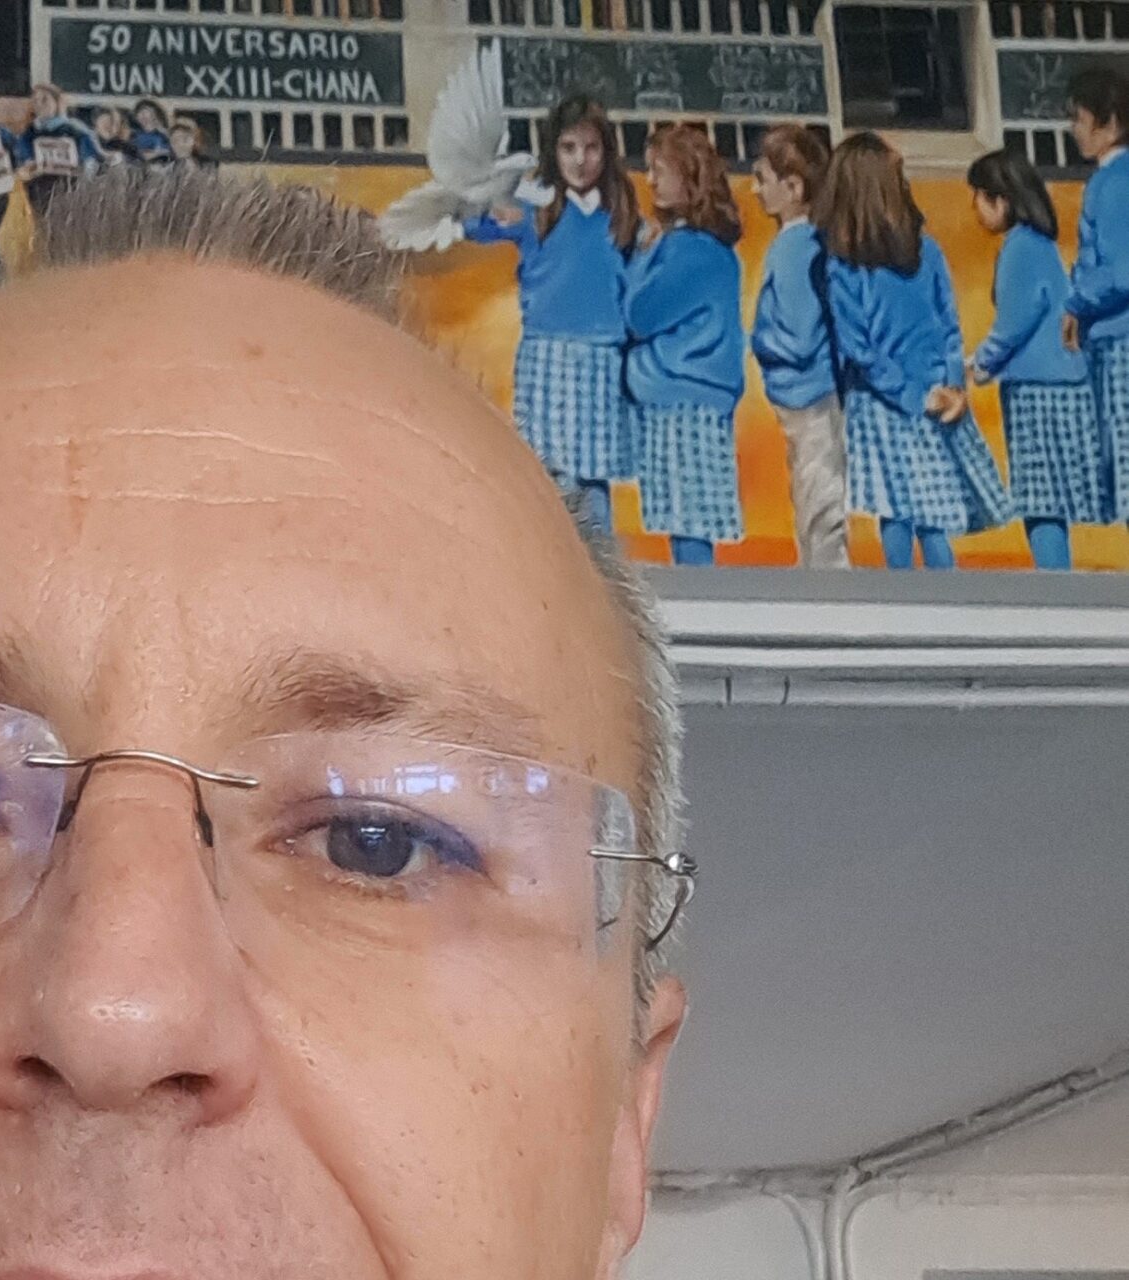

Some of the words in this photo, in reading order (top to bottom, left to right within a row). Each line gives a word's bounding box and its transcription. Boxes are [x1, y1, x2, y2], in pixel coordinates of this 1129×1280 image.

[87, 24, 132, 54] 50
[145, 25, 359, 61] ANIVERSARIO
[88, 63, 164, 94] JUAN
[183, 64, 382, 103] XXIII-CHANA
